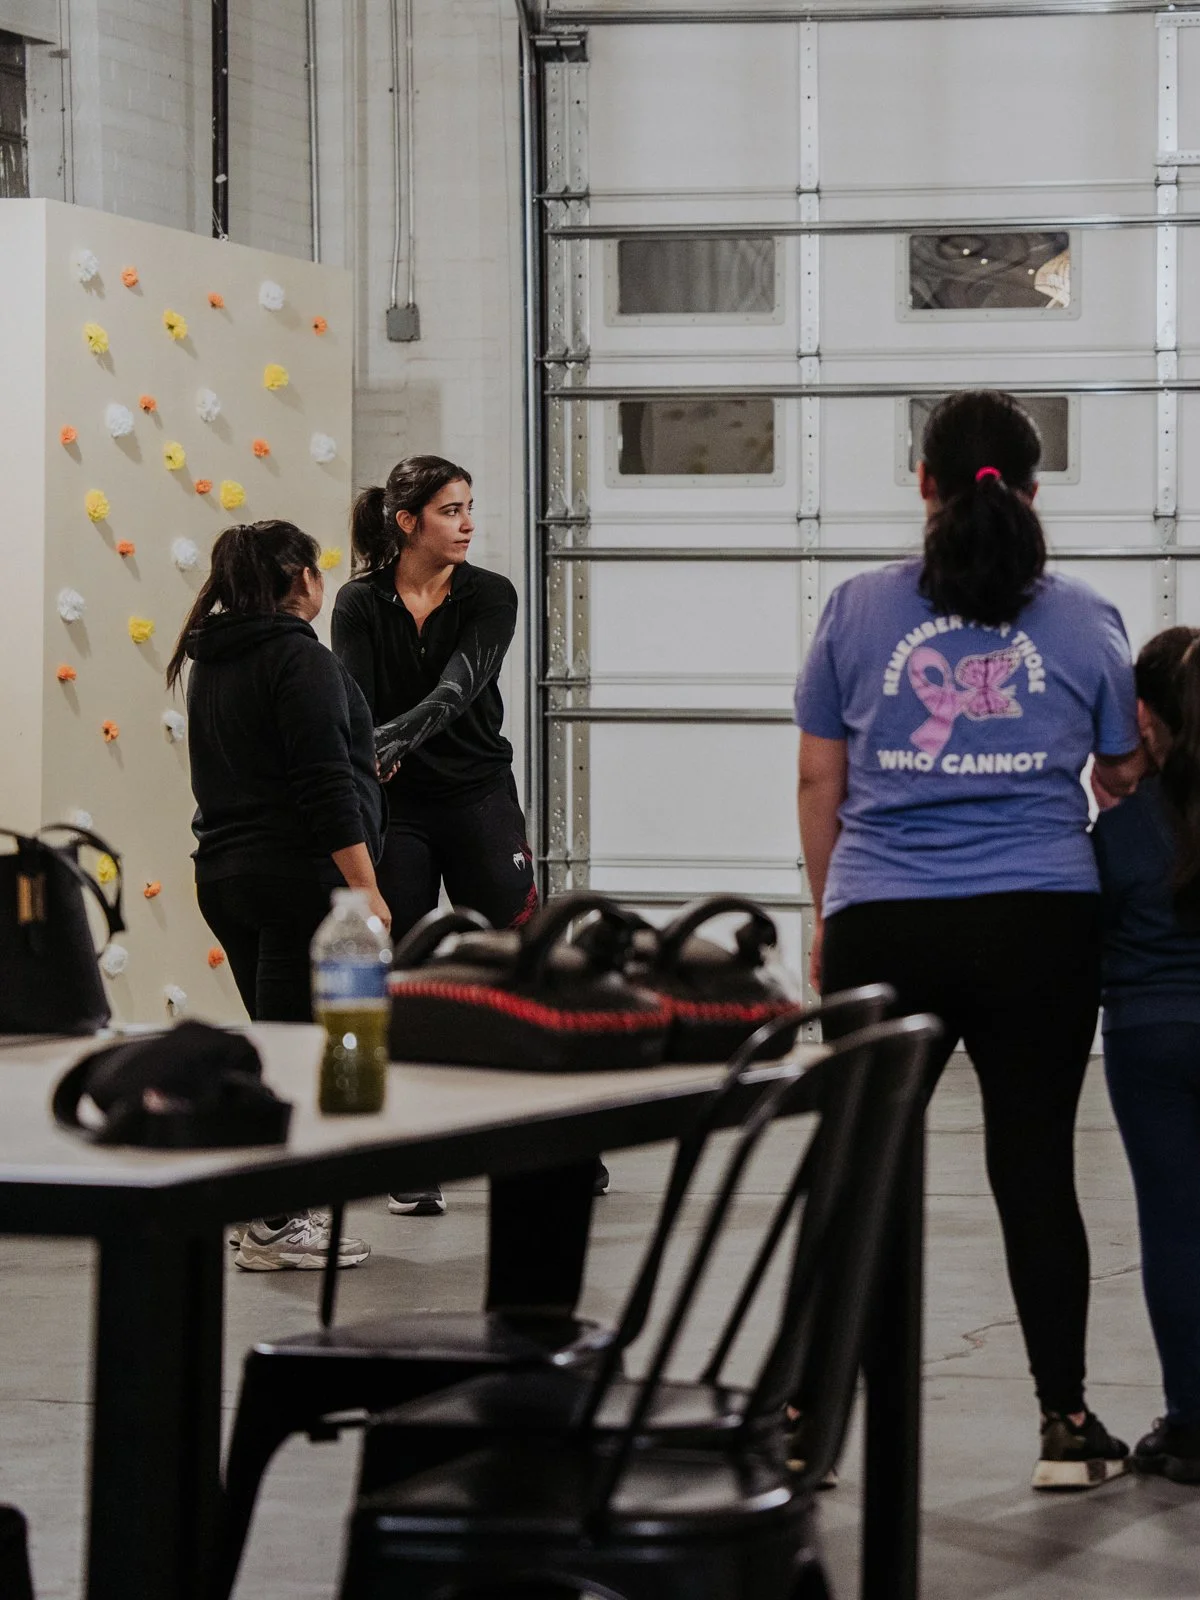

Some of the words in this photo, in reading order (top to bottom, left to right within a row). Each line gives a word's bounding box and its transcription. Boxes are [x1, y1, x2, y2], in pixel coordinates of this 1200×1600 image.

[882, 613, 964, 696] REMEMBER
[1011, 630, 1046, 694] THOSE
[877, 750, 935, 772] WHO
[941, 752, 1048, 775] CANNOT
